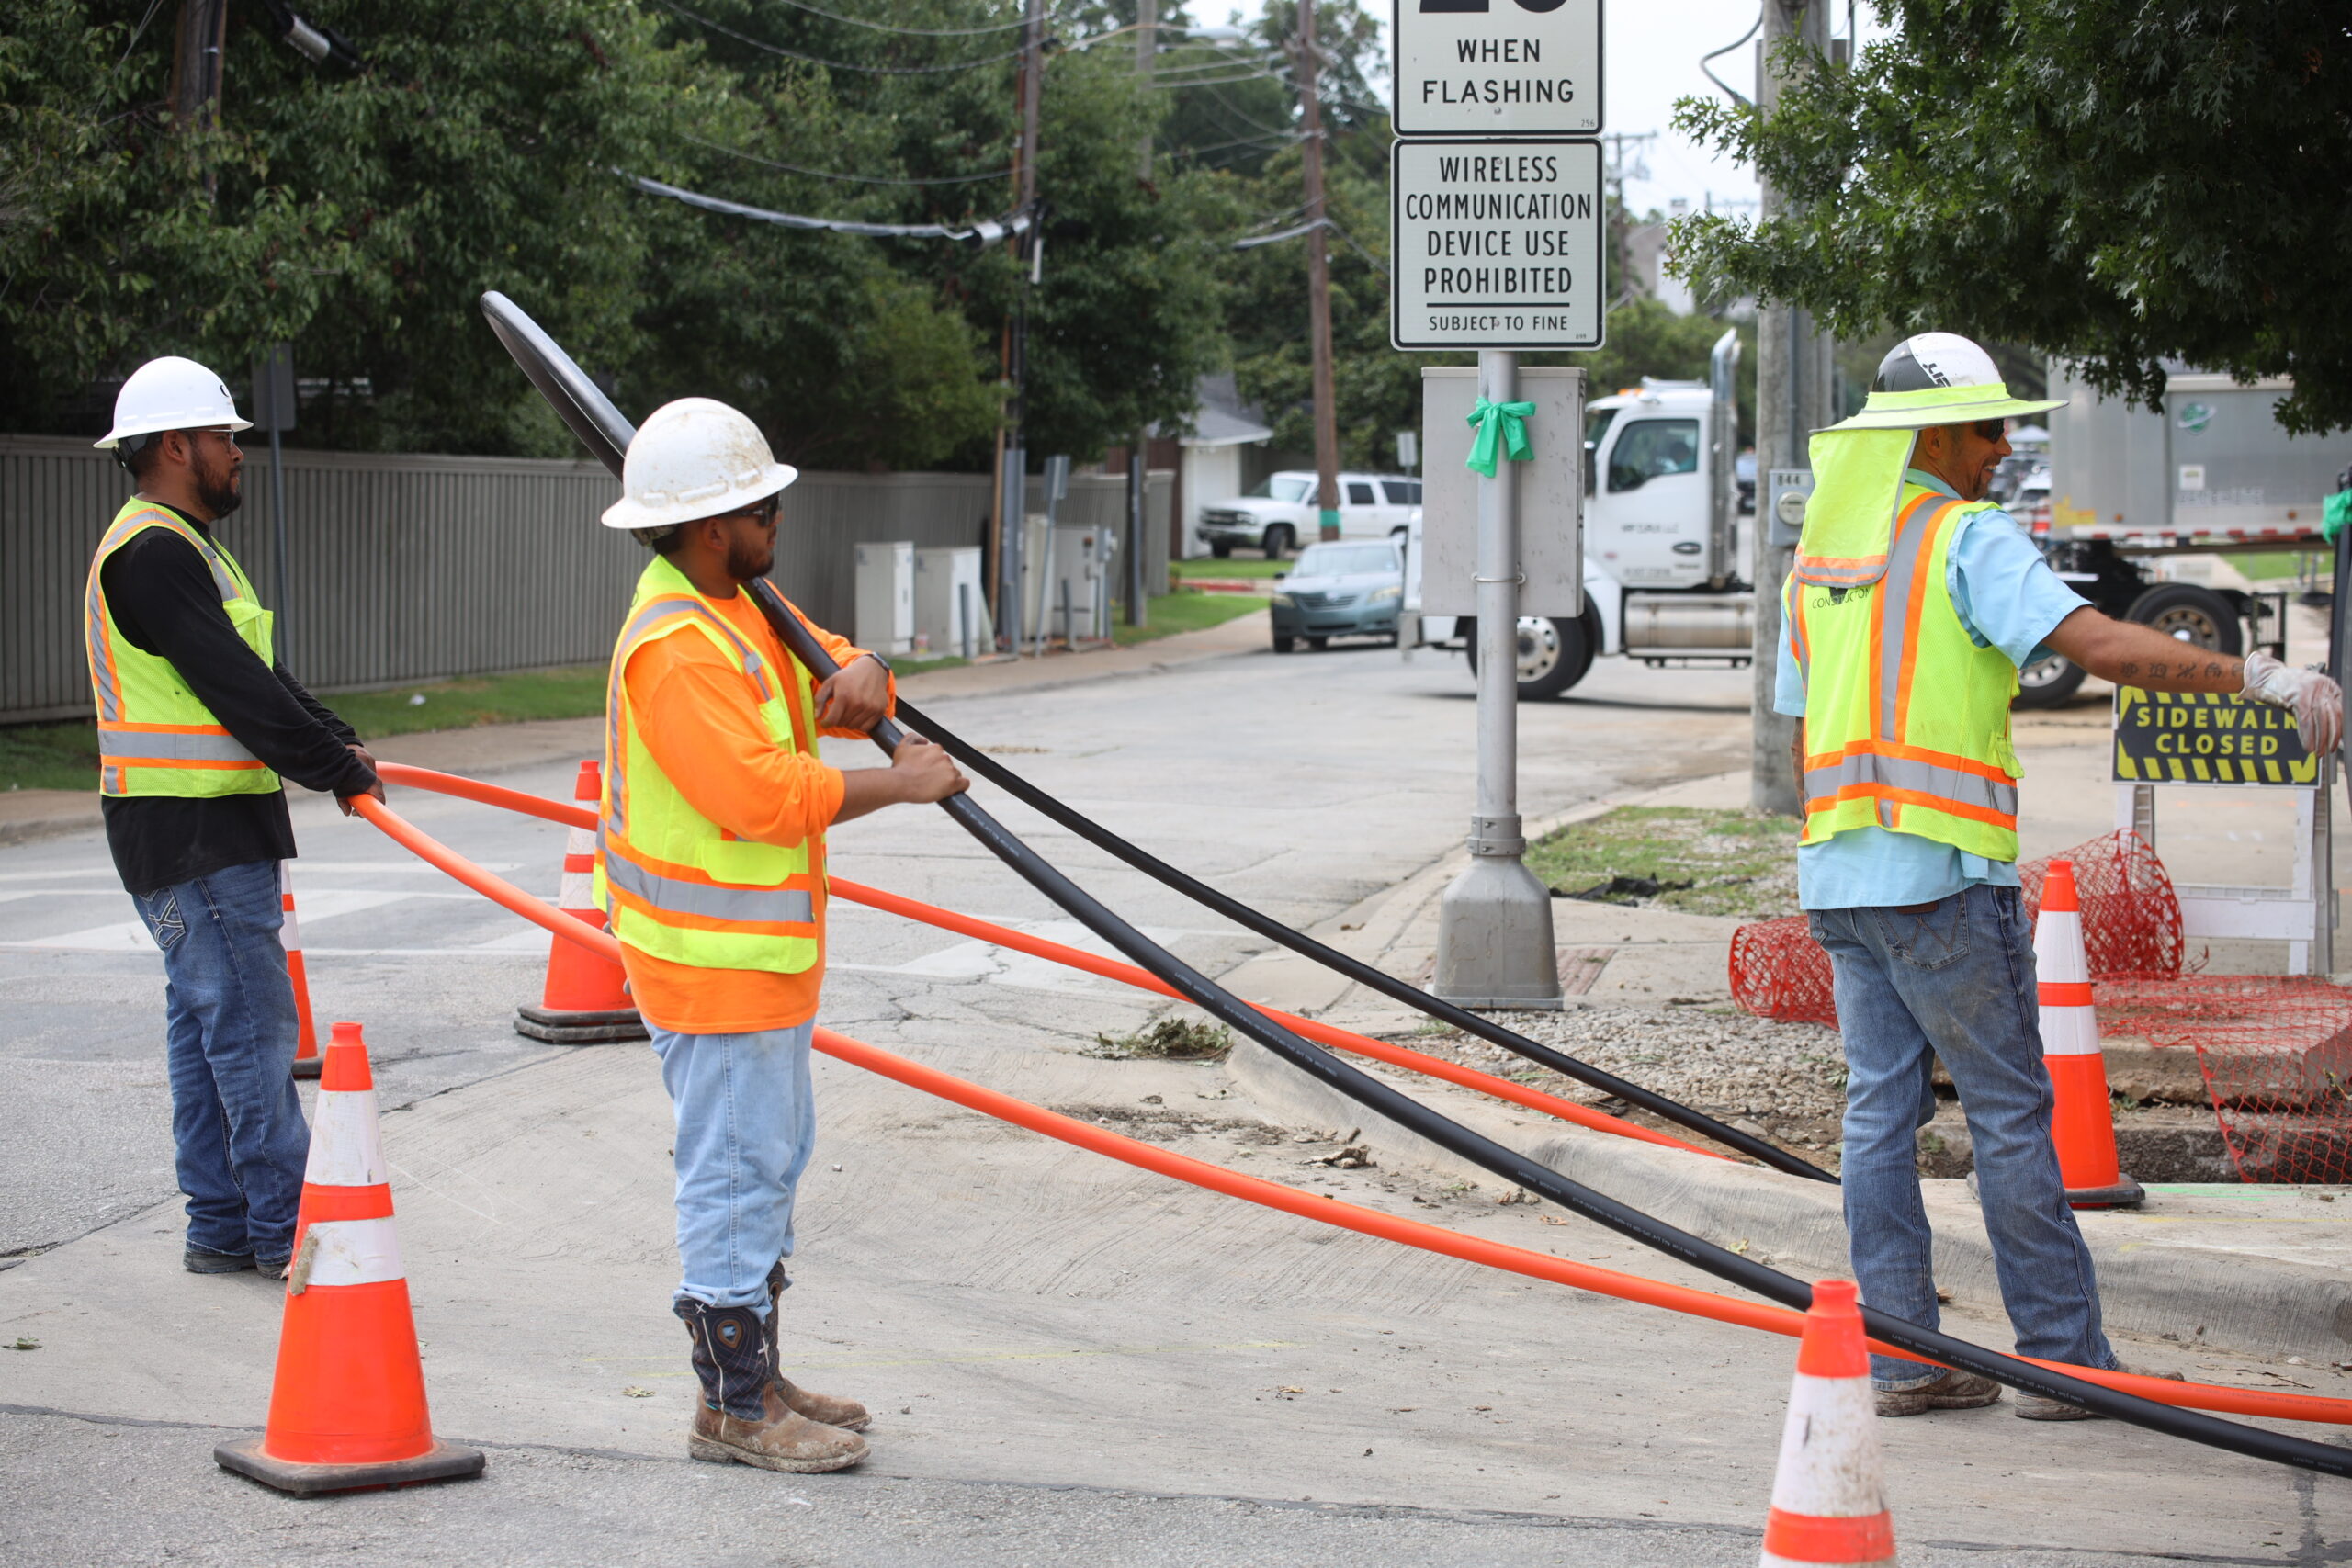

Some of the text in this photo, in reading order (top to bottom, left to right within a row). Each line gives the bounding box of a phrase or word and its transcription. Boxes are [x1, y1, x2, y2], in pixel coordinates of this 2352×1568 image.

[1457, 39, 1541, 62] WHEN
[1422, 80, 1574, 104] FLASHING
[1439, 156, 1558, 182] WIRELESS
[1406, 194, 1591, 220] COMMUNICATION
[1428, 231, 1569, 256] DEVICE USE
[1424, 267, 1572, 294] PROHIBITED
[1429, 316, 1567, 331] SUBJECT TO FINE
[2155, 733, 2279, 756] CLOSED
